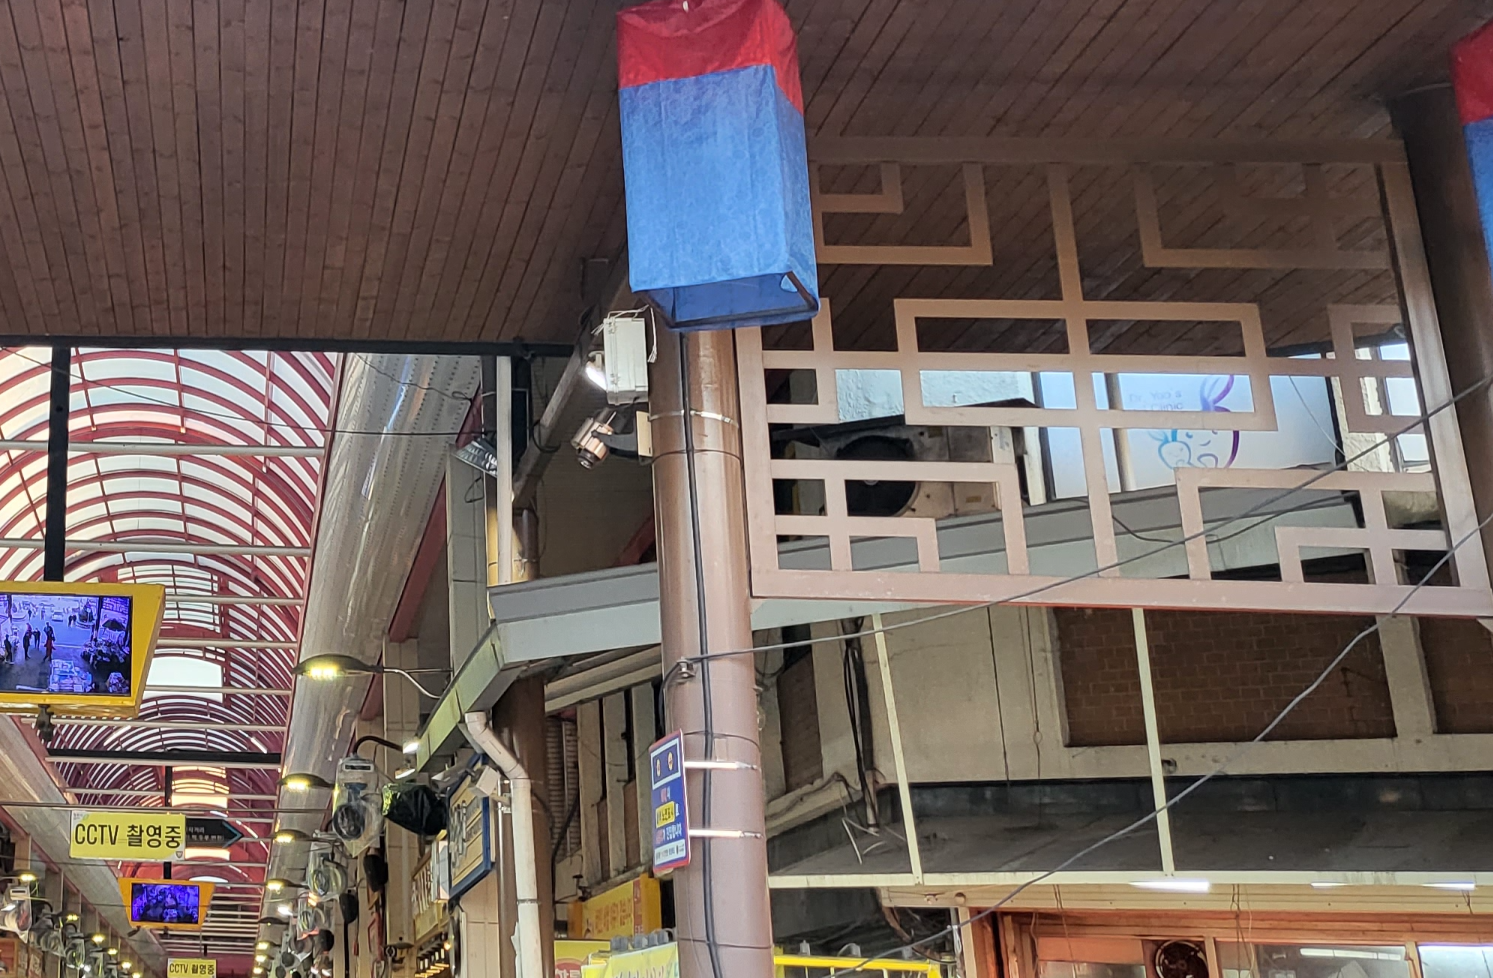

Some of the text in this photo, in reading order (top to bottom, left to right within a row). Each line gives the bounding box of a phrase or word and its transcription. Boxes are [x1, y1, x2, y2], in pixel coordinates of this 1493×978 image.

[74, 823, 182, 849] CCTV 촬영중
[169, 963, 189, 974] CCTV
